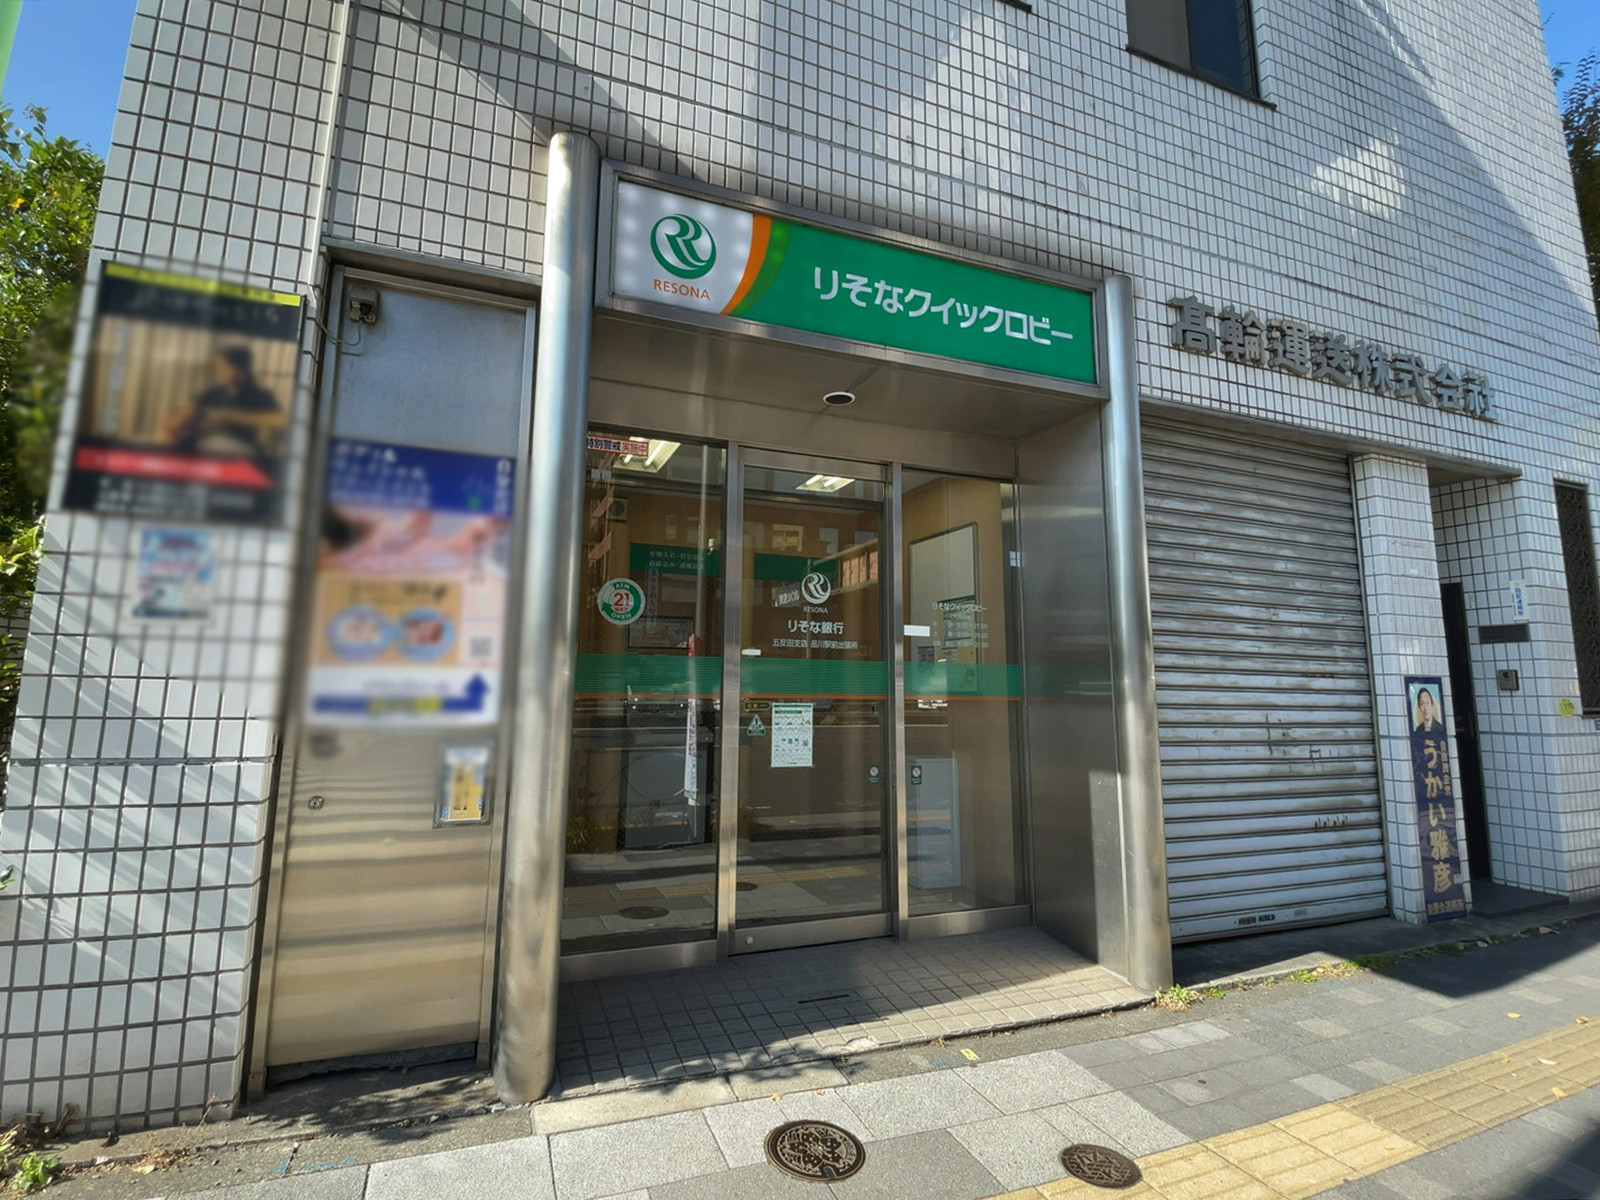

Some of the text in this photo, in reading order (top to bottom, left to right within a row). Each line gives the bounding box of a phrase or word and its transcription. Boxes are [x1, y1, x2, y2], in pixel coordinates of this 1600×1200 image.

[653, 278, 711, 301] RESONA
[814, 267, 1074, 346] りそなクイックロビー
[614, 592, 630, 606] 21
[788, 620, 844, 635] りそな銀行
[1423, 740, 1452, 893] うかい雅彦
